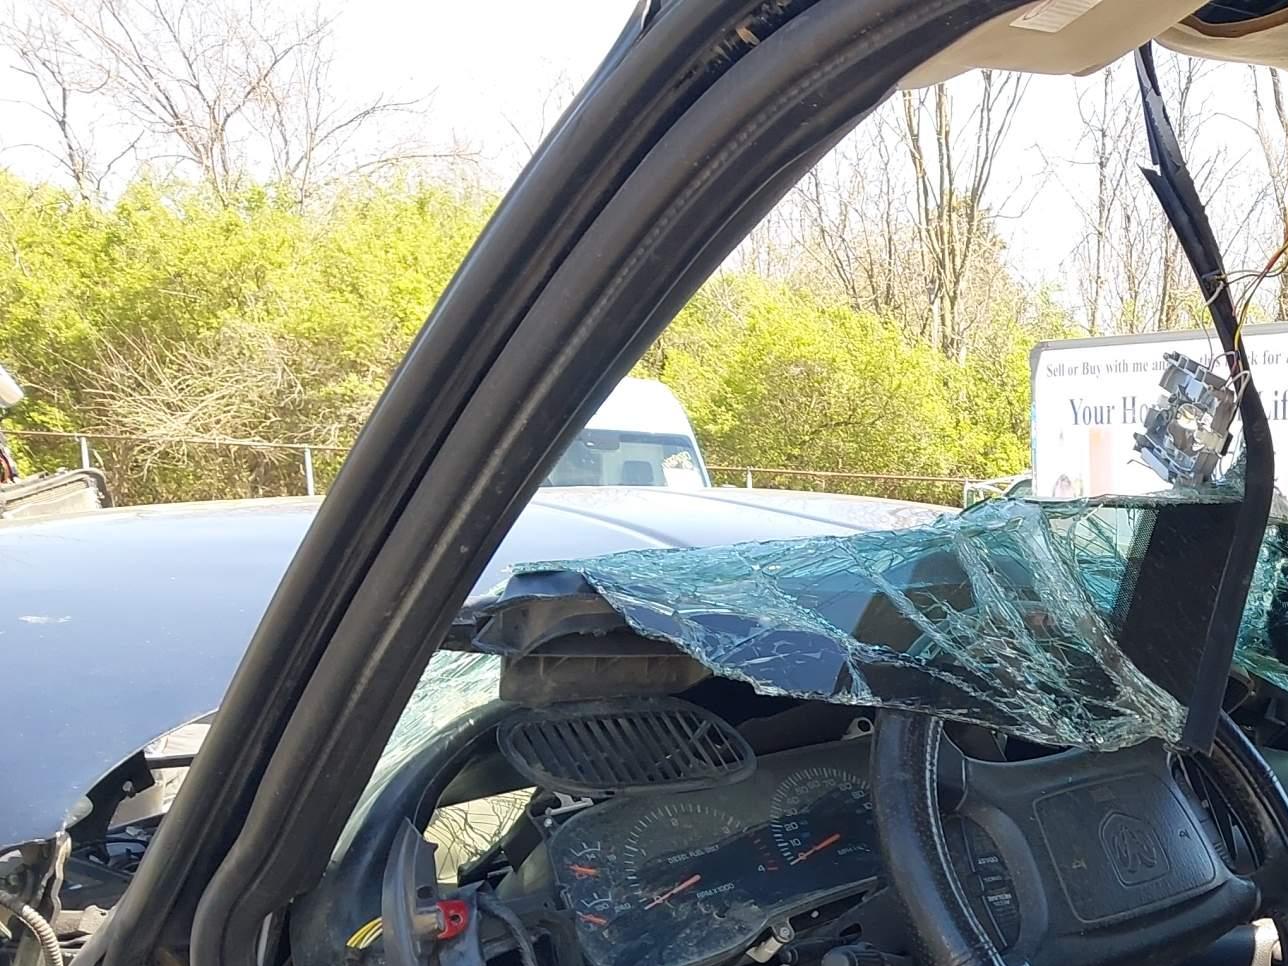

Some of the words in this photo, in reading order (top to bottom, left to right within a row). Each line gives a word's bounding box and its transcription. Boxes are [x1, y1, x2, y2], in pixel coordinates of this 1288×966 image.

[1046, 363, 1065, 377] Sell
[1067, 365, 1079, 376] or
[1082, 361, 1101, 378] Buy
[1106, 359, 1129, 374] with
[1132, 360, 1149, 373] me
[1152, 359, 1168, 371] an
[1263, 349, 1281, 365] for
[1069, 397, 1115, 425] Your
[784, 822, 799, 831] 20
[789, 838, 801, 847] 10
[757, 864, 766, 872] 4
